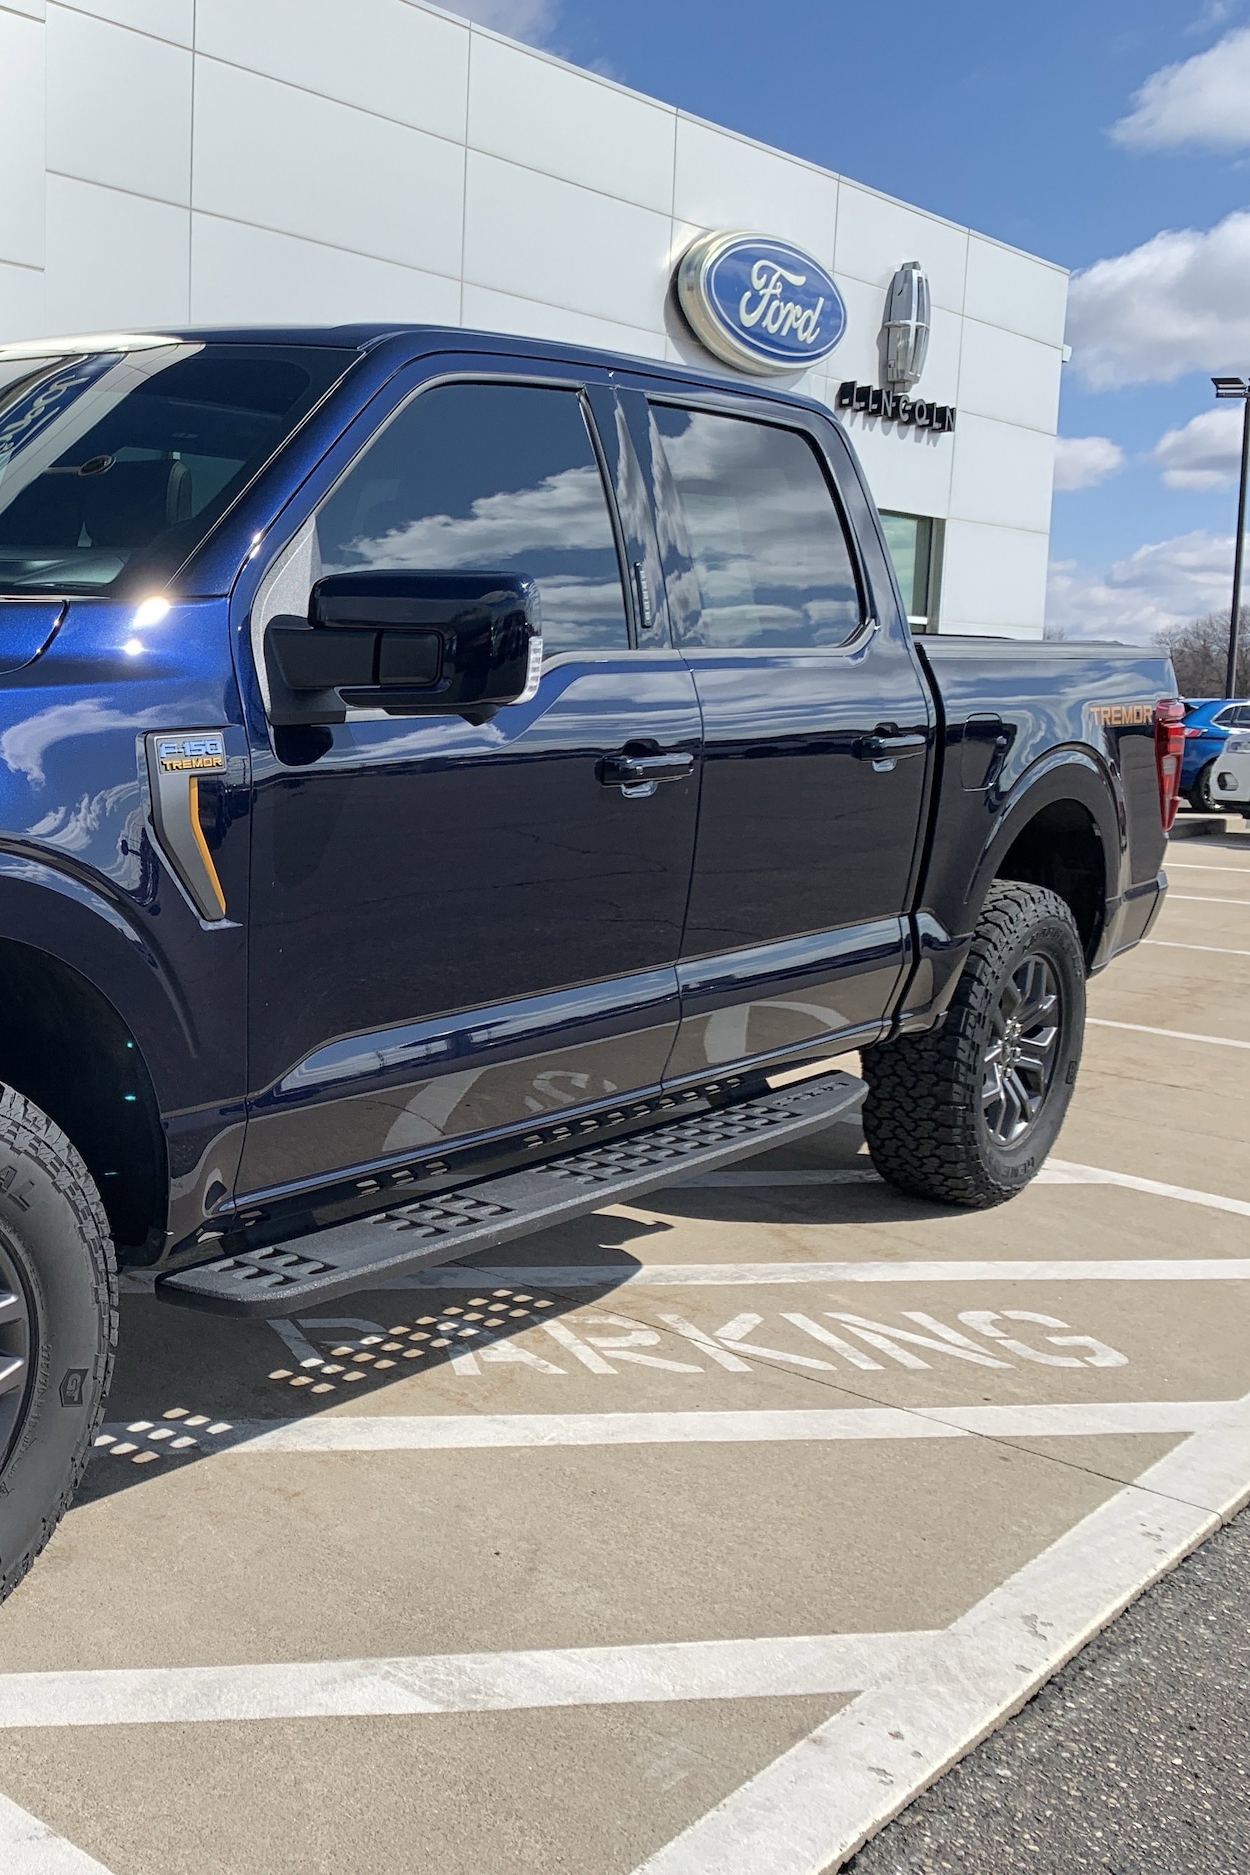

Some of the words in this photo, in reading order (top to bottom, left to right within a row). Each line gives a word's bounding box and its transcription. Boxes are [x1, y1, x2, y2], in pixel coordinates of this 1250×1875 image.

[739, 259, 824, 345] Ford
[844, 381, 956, 432] LINCOLN
[1090, 704, 1153, 726] TREMOR
[159, 740, 223, 758] F-150
[161, 757, 223, 771] TREMOR
[264, 1309, 1129, 1377] PARKING
